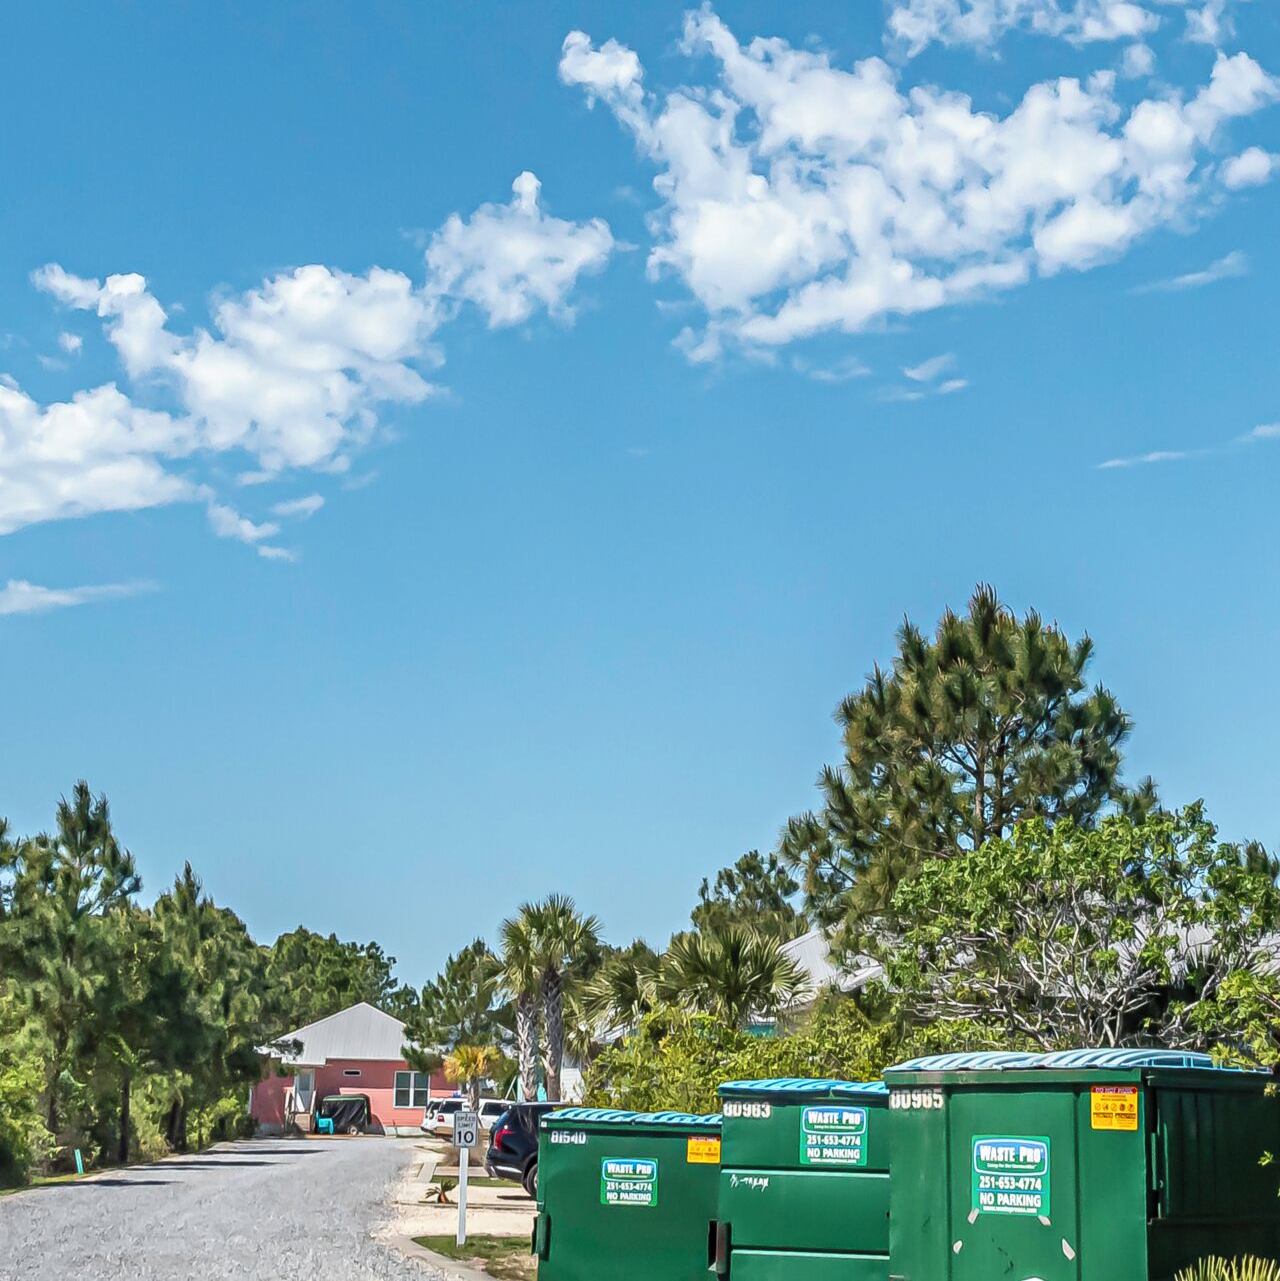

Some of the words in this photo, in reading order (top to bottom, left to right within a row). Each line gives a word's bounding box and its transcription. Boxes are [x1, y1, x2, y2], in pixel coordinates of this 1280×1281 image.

[808, 1111, 839, 1124] WASTE
[842, 1111, 861, 1125] PRO
[457, 1130, 474, 1143] 10
[807, 1134, 861, 1146] 251-653-4774
[807, 1148, 820, 1158] NO
[822, 1148, 860, 1159] PARKING
[980, 1145, 1016, 1162] WASTE
[1019, 1146, 1041, 1163] PRO
[979, 1175, 1042, 1191] 251-653-4774
[606, 1192, 619, 1200] NO
[620, 1192, 652, 1202] PARKING
[979, 1192, 995, 1205] NO
[997, 1193, 1042, 1208] PARKING
